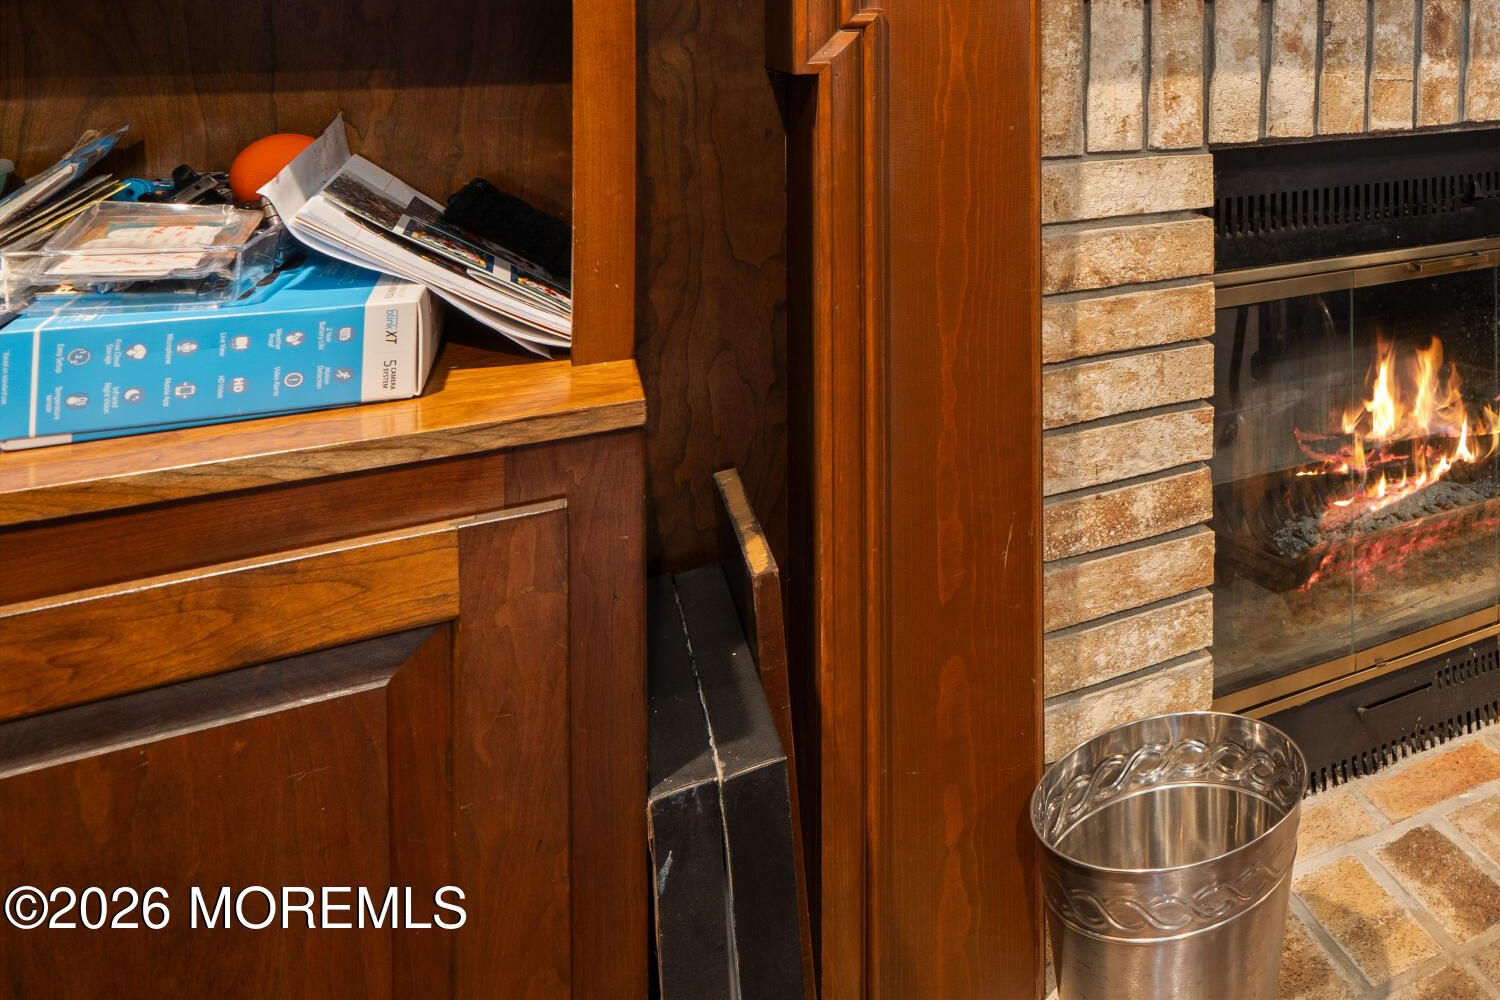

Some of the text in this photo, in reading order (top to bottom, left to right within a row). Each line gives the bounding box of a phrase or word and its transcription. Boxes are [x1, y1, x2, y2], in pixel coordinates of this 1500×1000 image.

[318, 321, 326, 340] Battery
[386, 309, 398, 344] blink XT
[165, 334, 174, 365] Microphone
[273, 366, 281, 381] Video
[233, 377, 244, 393] HD
